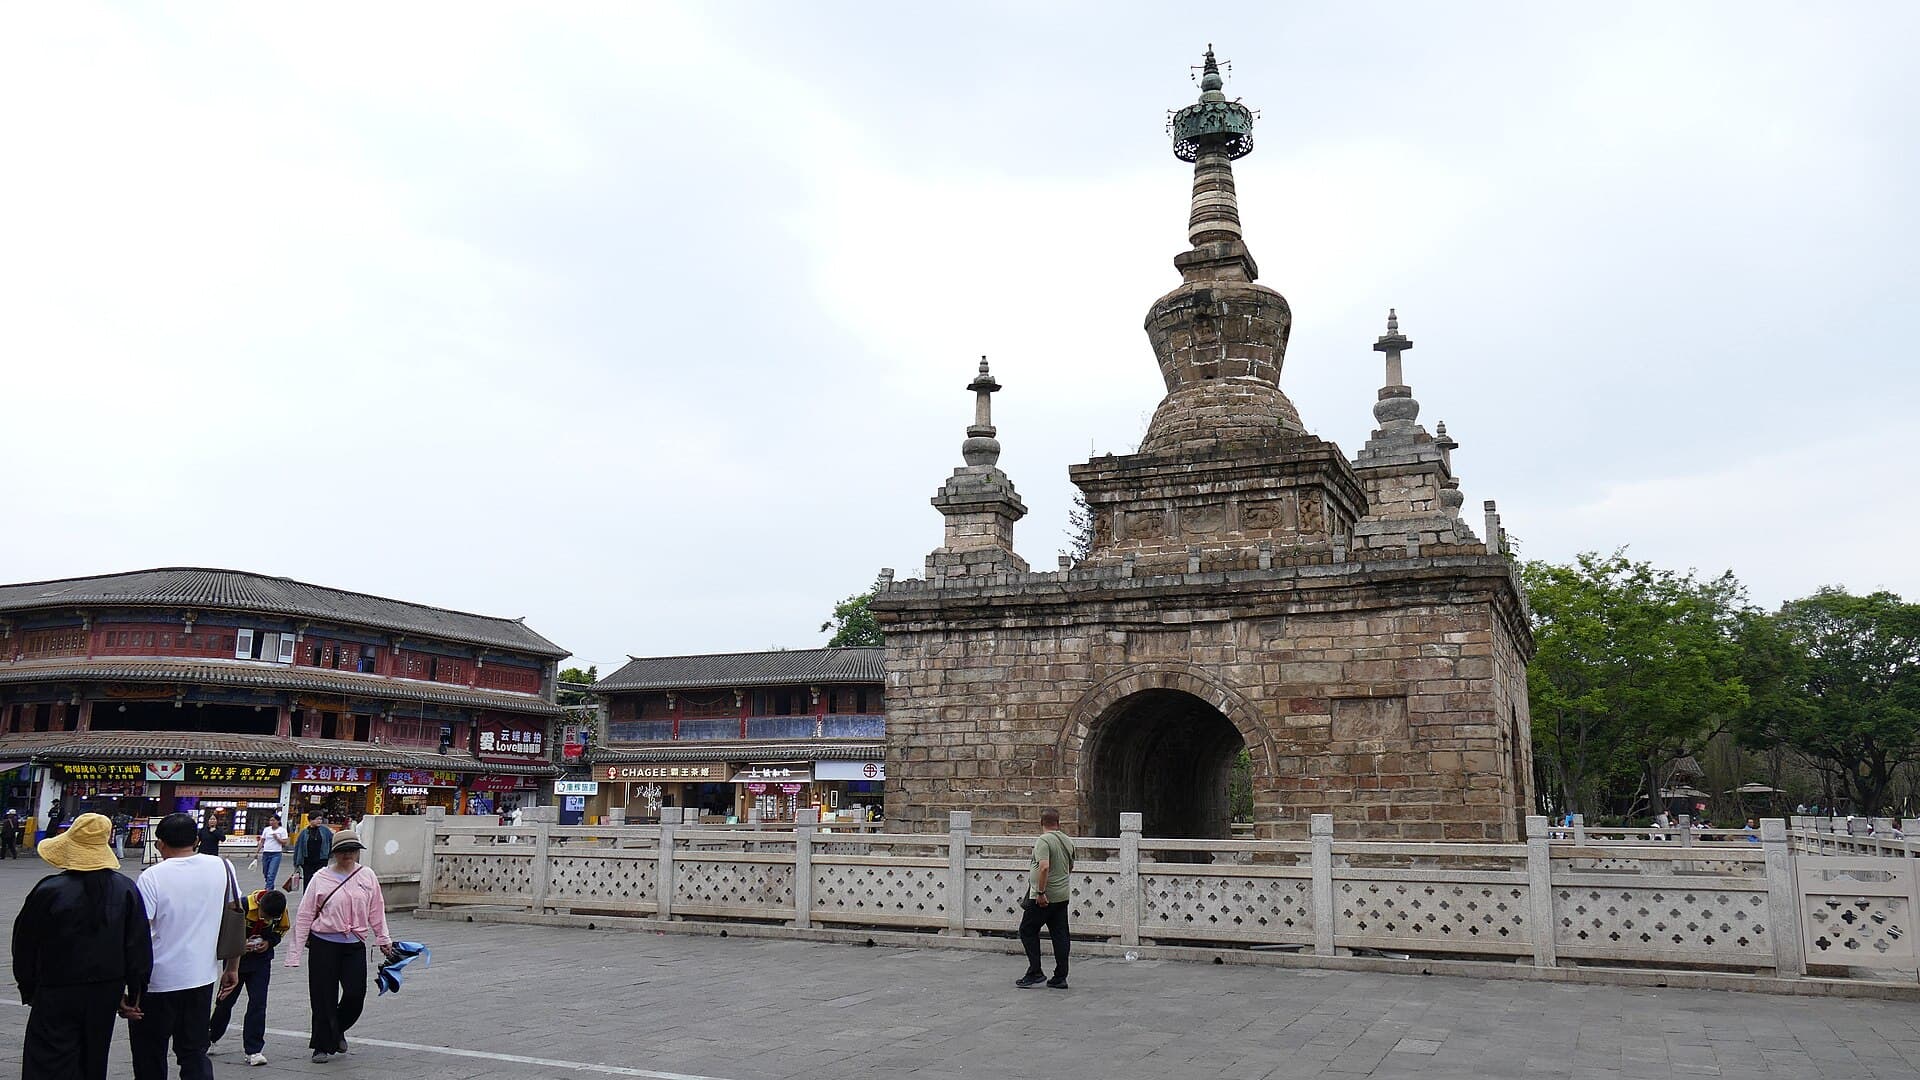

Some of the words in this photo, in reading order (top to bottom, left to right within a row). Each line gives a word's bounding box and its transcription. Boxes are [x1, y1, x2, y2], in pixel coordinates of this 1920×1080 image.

[304, 766, 359, 781] 文创市集
[621, 767, 667, 777] CHAGEE
[670, 767, 710, 777] 霸王茶姬
